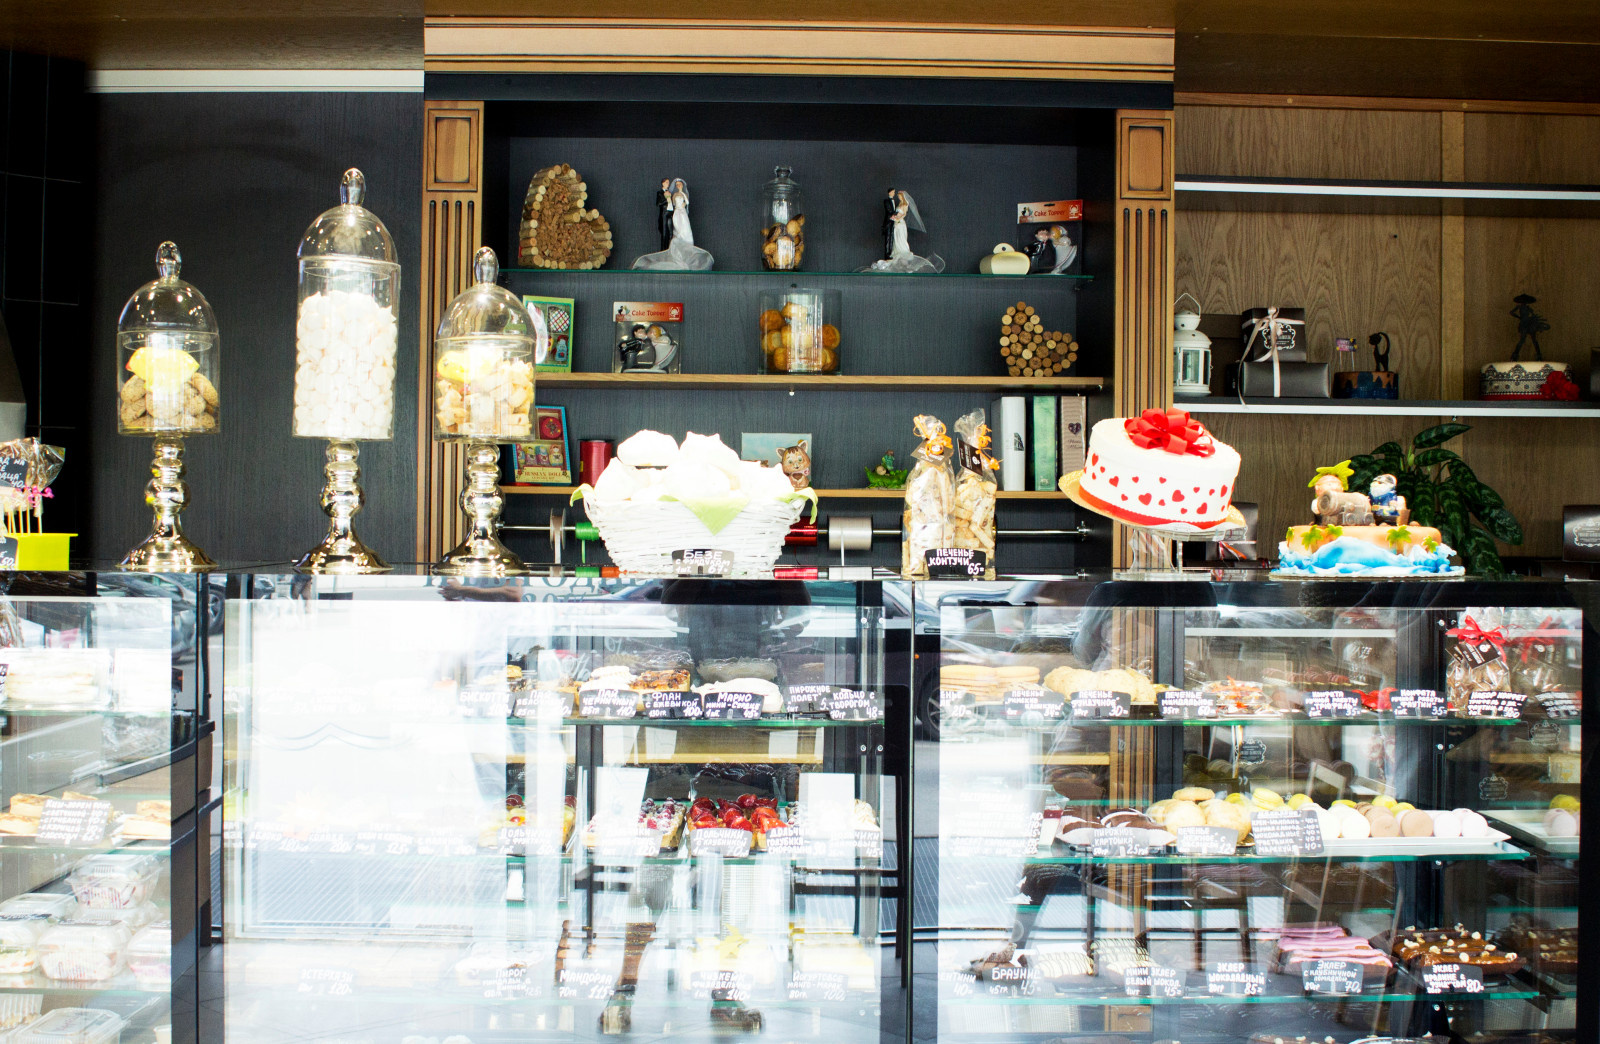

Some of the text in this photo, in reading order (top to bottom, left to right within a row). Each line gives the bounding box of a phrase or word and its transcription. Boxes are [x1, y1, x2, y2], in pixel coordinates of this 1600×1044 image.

[683, 549, 723, 560] БЕЗЕ
[936, 548, 974, 558] ПЕЧЕНЬЕ
[597, 689, 619, 698] ПАЙ
[789, 685, 831, 694] ПИРОЖНОЕ
[1078, 690, 1113, 699] ПЕЧЕНЬЕ
[1164, 690, 1203, 699] ПЕЧЕНЬЕ
[651, 692, 682, 702] ФЛАН
[832, 691, 866, 701] КОЛЬЦО
[828, 698, 871, 709] ТВОРОГОМ
[1093, 828, 1134, 837] ПИРОЖНОЕ
[1216, 962, 1245, 973] ЭКЛЕР
[1316, 959, 1347, 970] ЭКЛЕР
[1432, 964, 1460, 974] ЭКЛЕР
[495, 967, 527, 978] ПИРОГ
[1126, 966, 1177, 977] МИНИ ЭКЛЕР
[1125, 976, 1152, 986] БЕЛЫЙ
[1208, 972, 1265, 984] ШОКОЛАДНЫЙ
